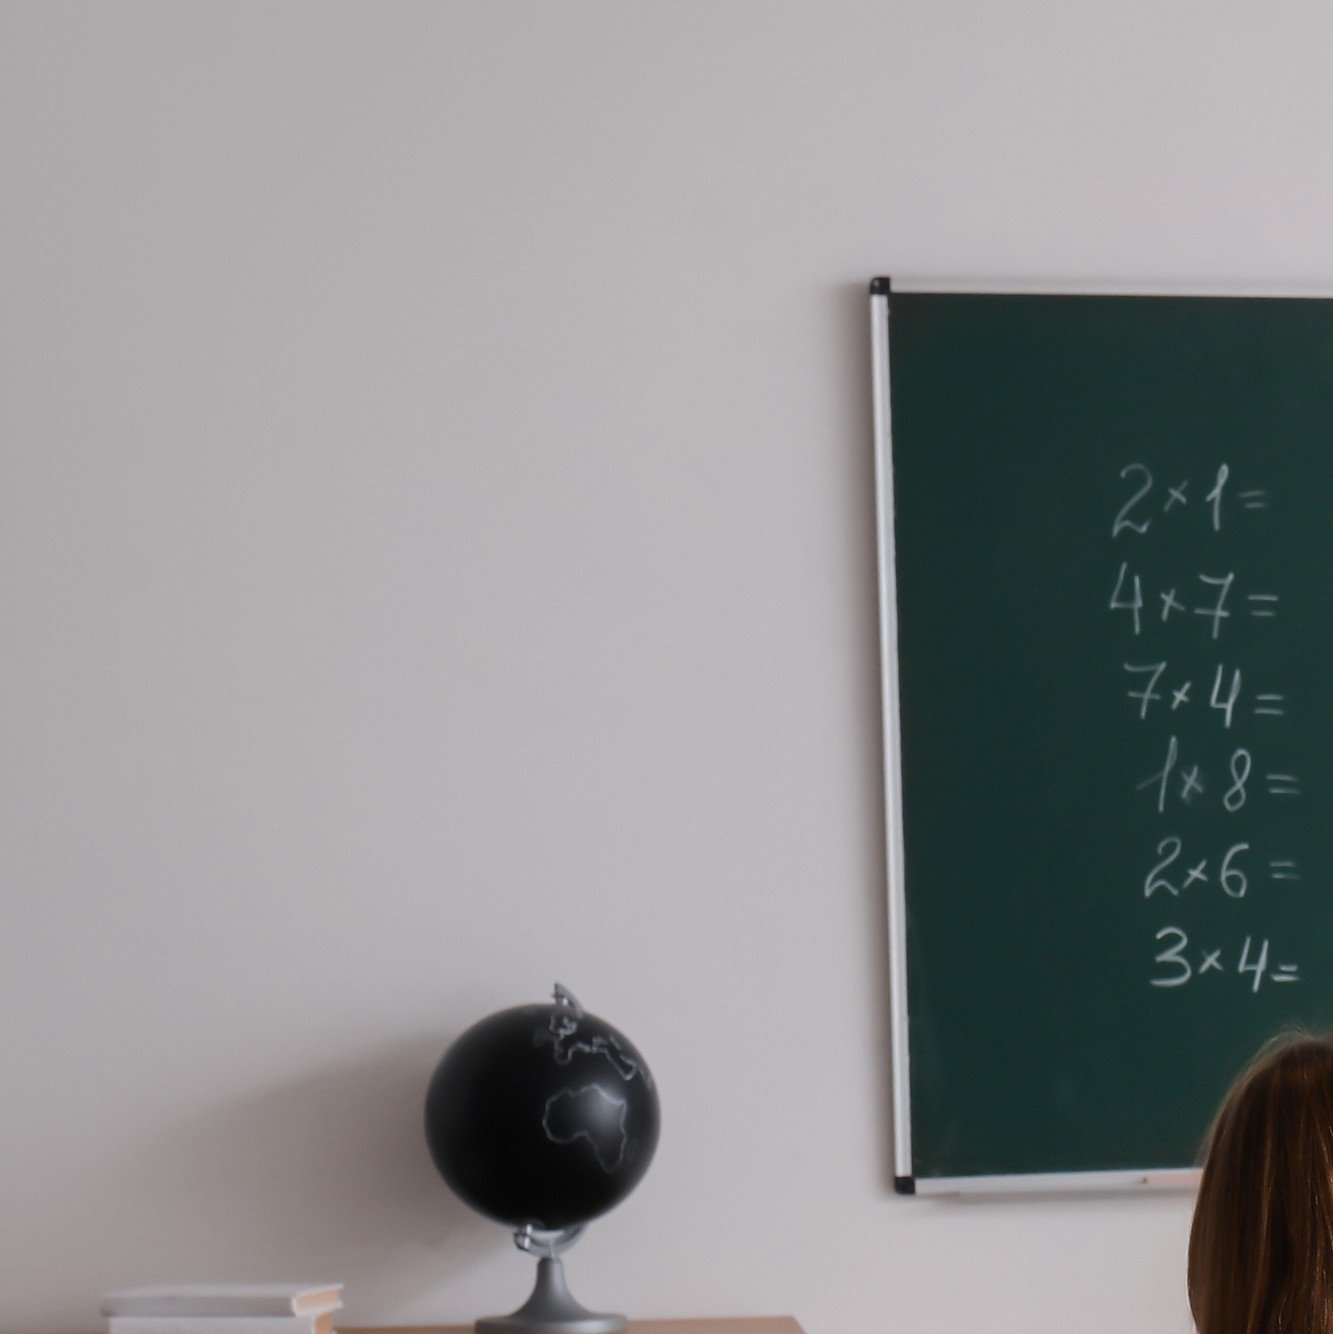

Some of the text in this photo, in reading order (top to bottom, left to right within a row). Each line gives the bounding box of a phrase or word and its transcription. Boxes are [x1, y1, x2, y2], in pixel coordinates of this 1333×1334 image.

[1112, 463, 1153, 538] 2
[1205, 463, 1229, 531] 1
[1110, 562, 1143, 635] 4
[1194, 572, 1234, 639] 7
[1123, 661, 1167, 719] 7
[1211, 664, 1241, 728] 4
[1136, 735, 1178, 813] 1
[1223, 748, 1251, 812] 8
[1144, 837, 1181, 898] 2
[1220, 842, 1249, 898] 6
[1150, 926, 1192, 987] 3
[1238, 936, 1268, 993] 4
